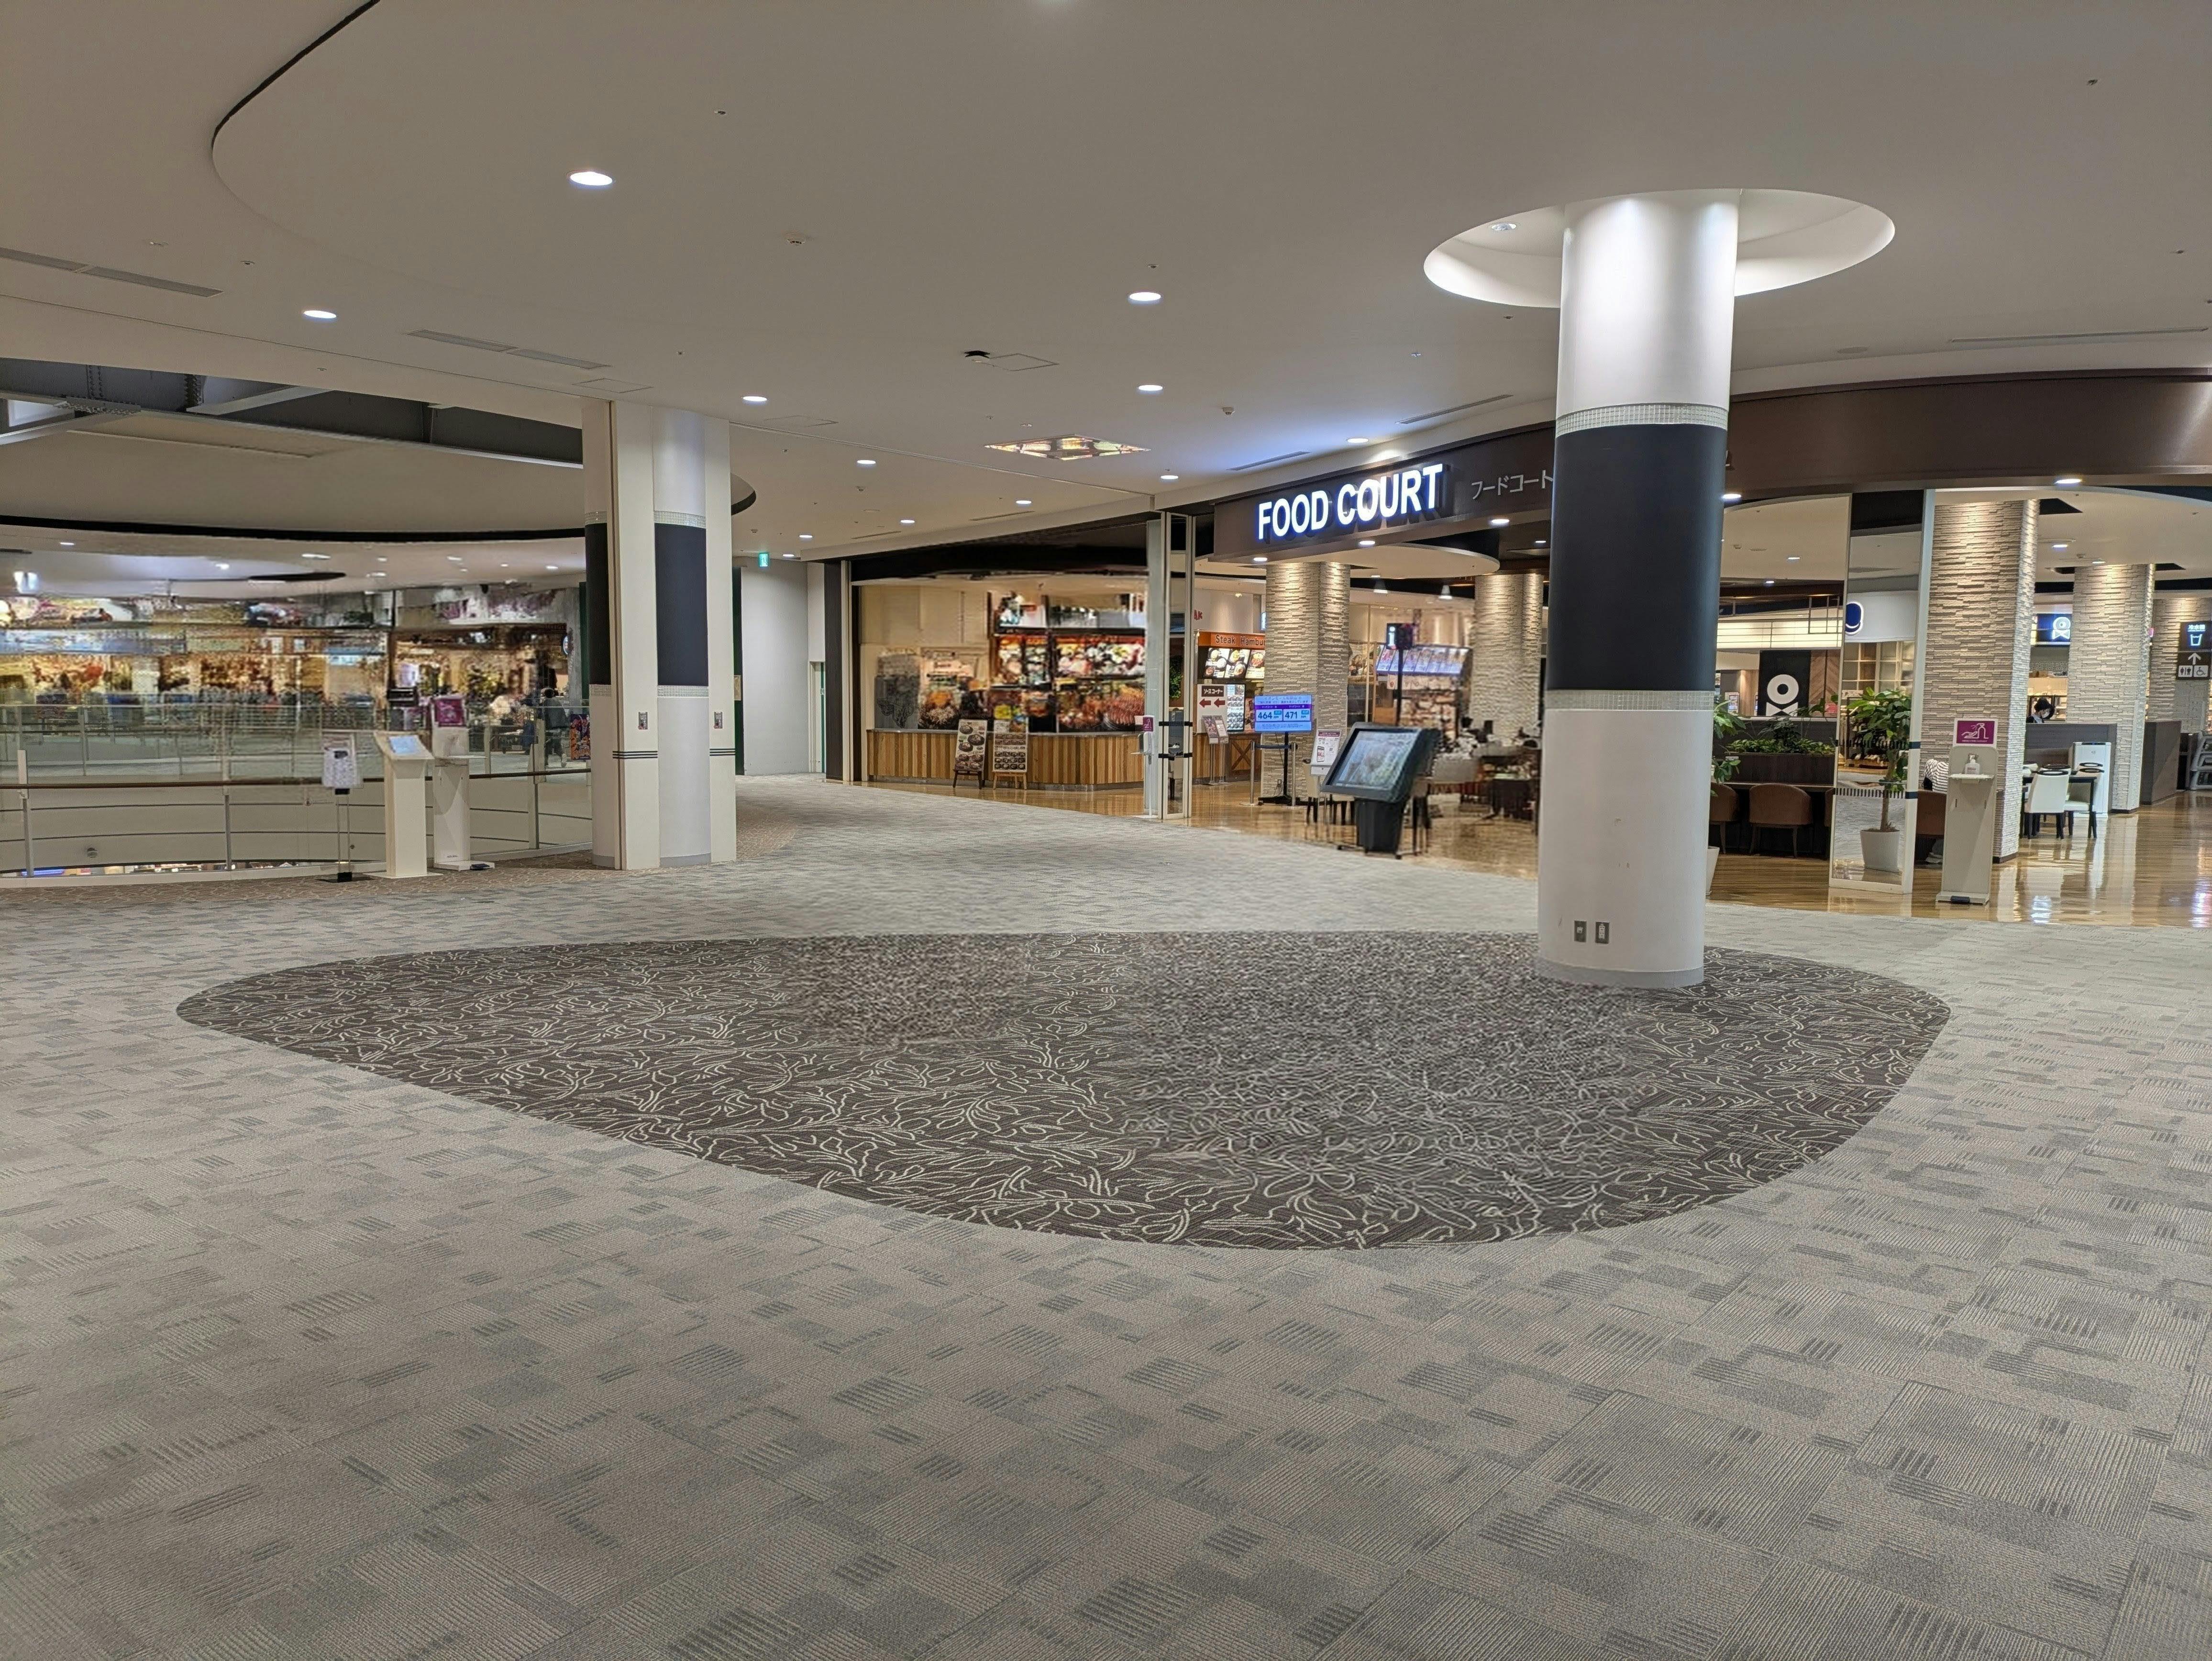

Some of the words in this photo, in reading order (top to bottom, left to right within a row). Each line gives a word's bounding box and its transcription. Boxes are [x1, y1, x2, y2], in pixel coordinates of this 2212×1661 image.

[1471, 470, 1554, 499] フードコート
[1259, 490, 1328, 539] FOOD
[1338, 464, 1443, 525] COURT
[1216, 634, 1236, 644] Steak
